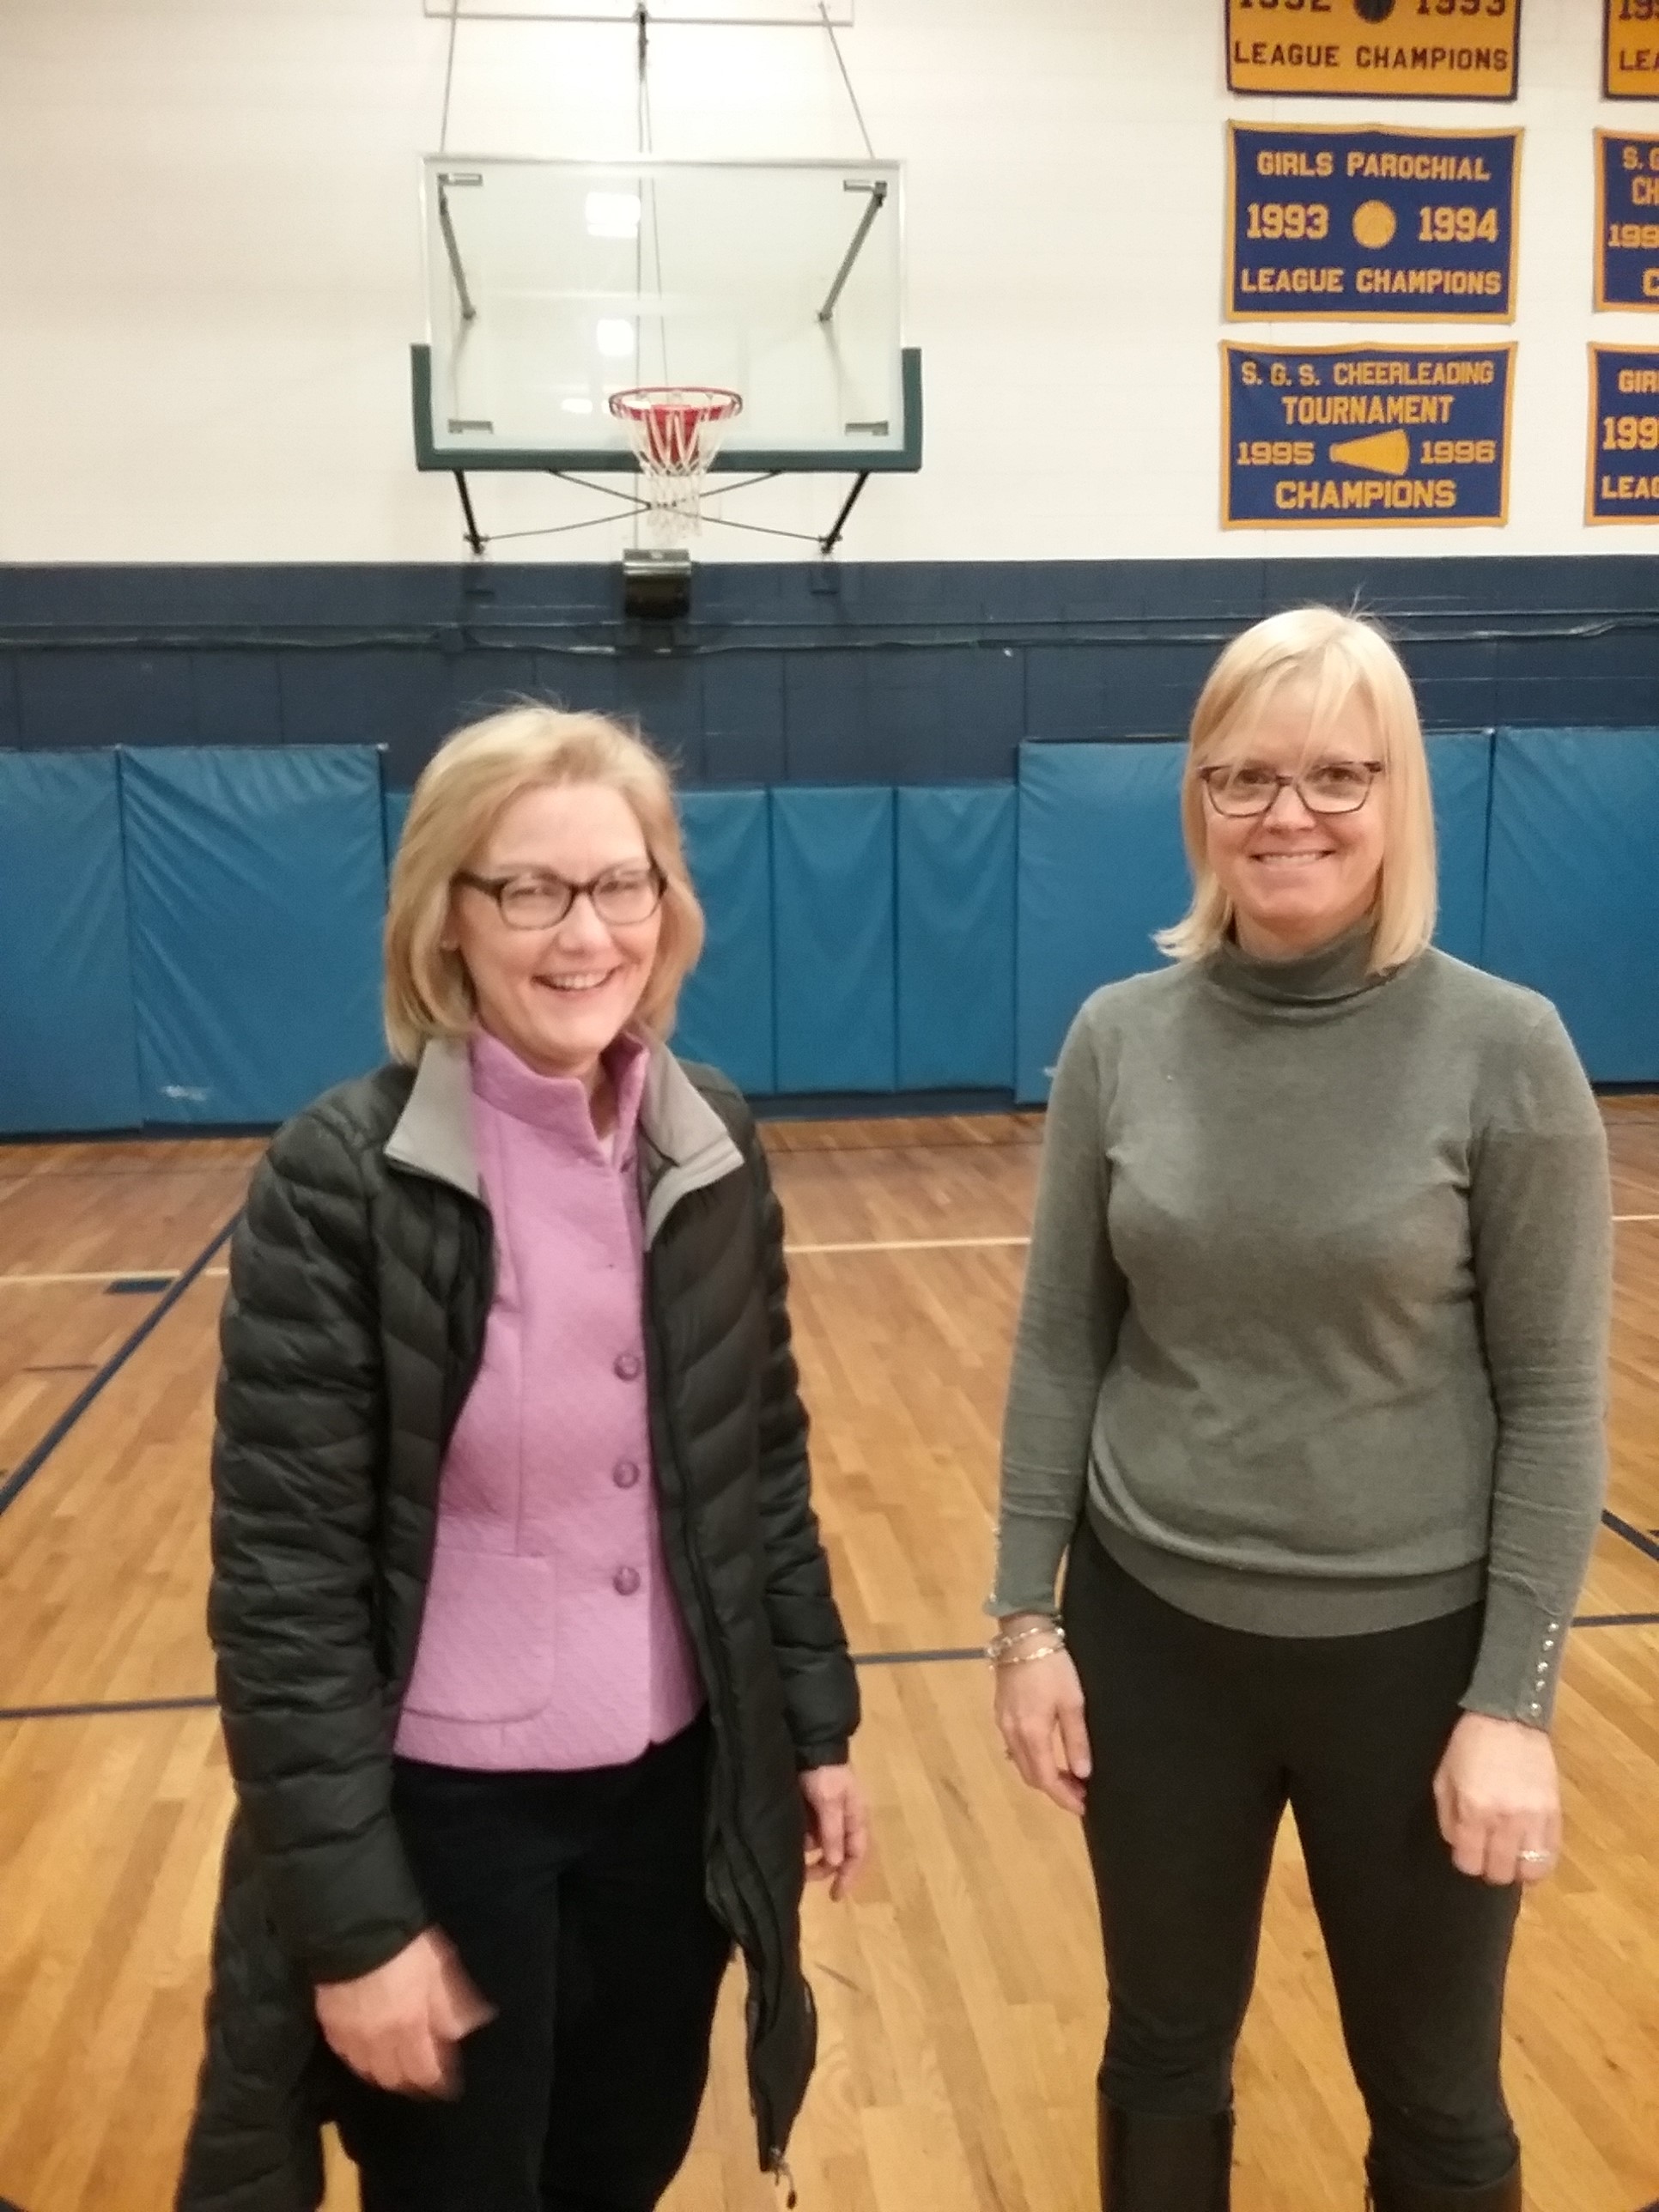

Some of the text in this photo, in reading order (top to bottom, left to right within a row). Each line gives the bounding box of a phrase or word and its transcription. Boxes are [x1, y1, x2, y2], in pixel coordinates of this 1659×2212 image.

[1233, 40, 1509, 72] LEAGUE CHAMPIONS
[1256, 150, 1491, 181] GIRLS PAROCHIAL
[1247, 203, 1329, 240] 1993
[1419, 206, 1498, 242] 1994
[1241, 267, 1502, 295] LEAGUE CHAMPIONS
[1242, 360, 1262, 386] S.
[1298, 363, 1321, 387] S.
[1333, 361, 1495, 386] CHEERLEADING
[1282, 395, 1455, 424] TOURNAMENT
[1237, 441, 1315, 465] 1995
[1420, 440, 1498, 465] 1996
[1275, 479, 1457, 509] CHAMPIONS
